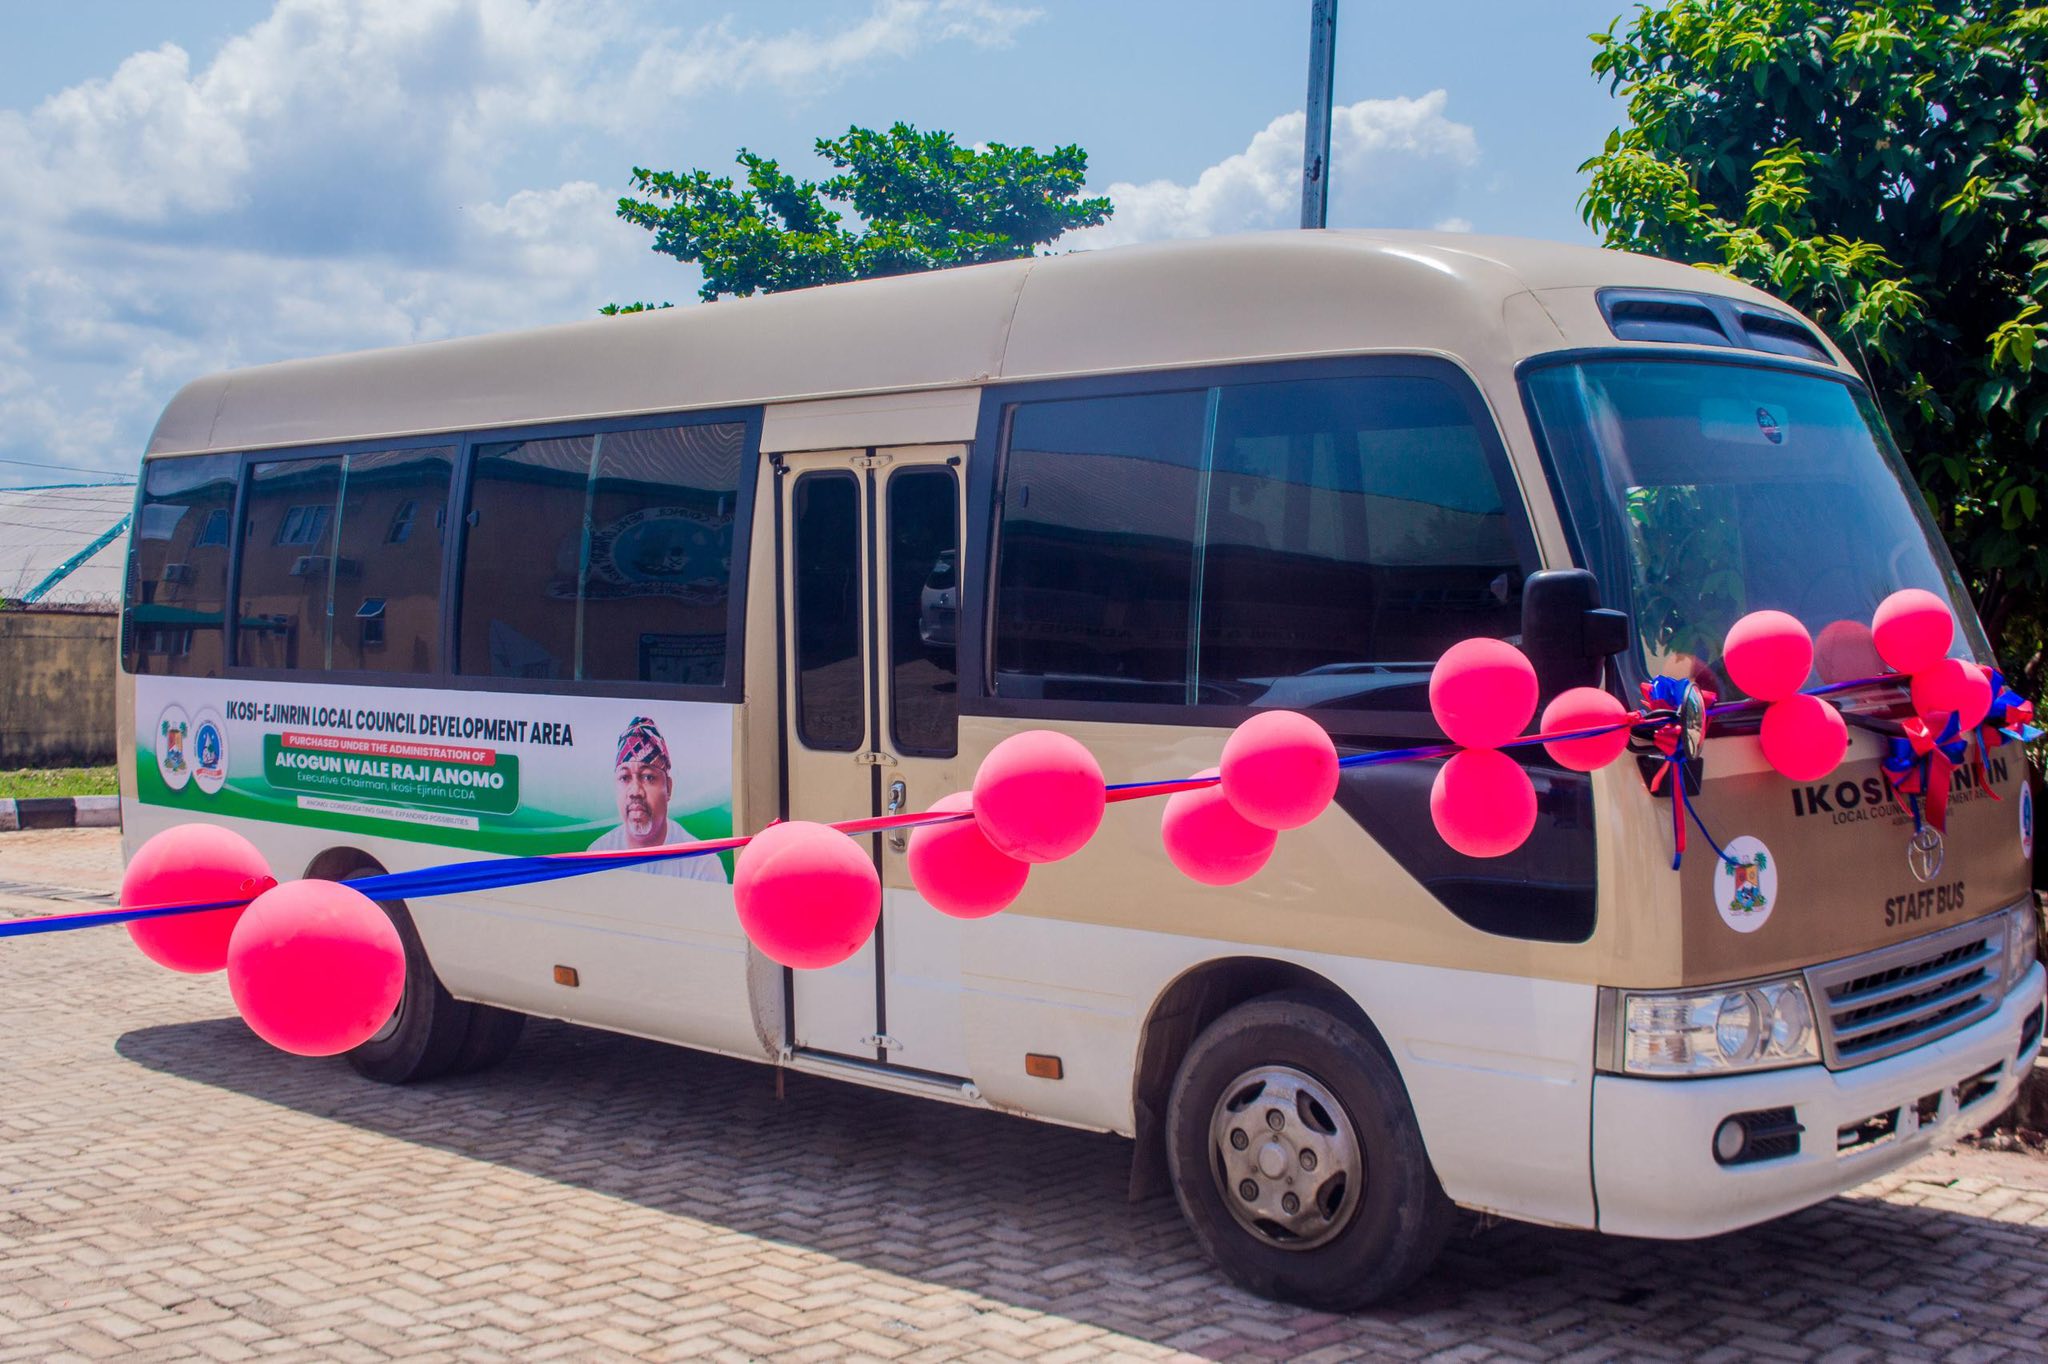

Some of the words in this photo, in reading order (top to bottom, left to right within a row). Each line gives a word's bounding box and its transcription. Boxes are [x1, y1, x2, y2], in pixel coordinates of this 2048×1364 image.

[226, 700, 311, 725] IKOSI-EJINRIN
[312, 707, 353, 729] LOCAL
[355, 710, 416, 735] COUNCIL
[419, 714, 528, 743] DEVELOPMENT
[529, 721, 574, 747] AREA
[289, 736, 340, 748] PURCHASED
[340, 741, 369, 752] UNDER
[371, 744, 388, 753] THE
[389, 745, 471, 760] ADMINISTRATION
[472, 752, 486, 762] OF
[275, 752, 341, 773] AKOGUN
[343, 758, 390, 778] WALE
[391, 763, 430, 782] RAJI
[432, 767, 504, 790] ANOMO
[297, 771, 339, 785] Executive
[340, 776, 390, 791] Chairman,
[391, 782, 446, 797] Ikosi-Ejinrin
[448, 788, 476, 800] LCDA
[1832, 810, 1869, 825] LOCAL
[1885, 888, 1935, 927] STAFF
[1937, 881, 1965, 914] BUS
